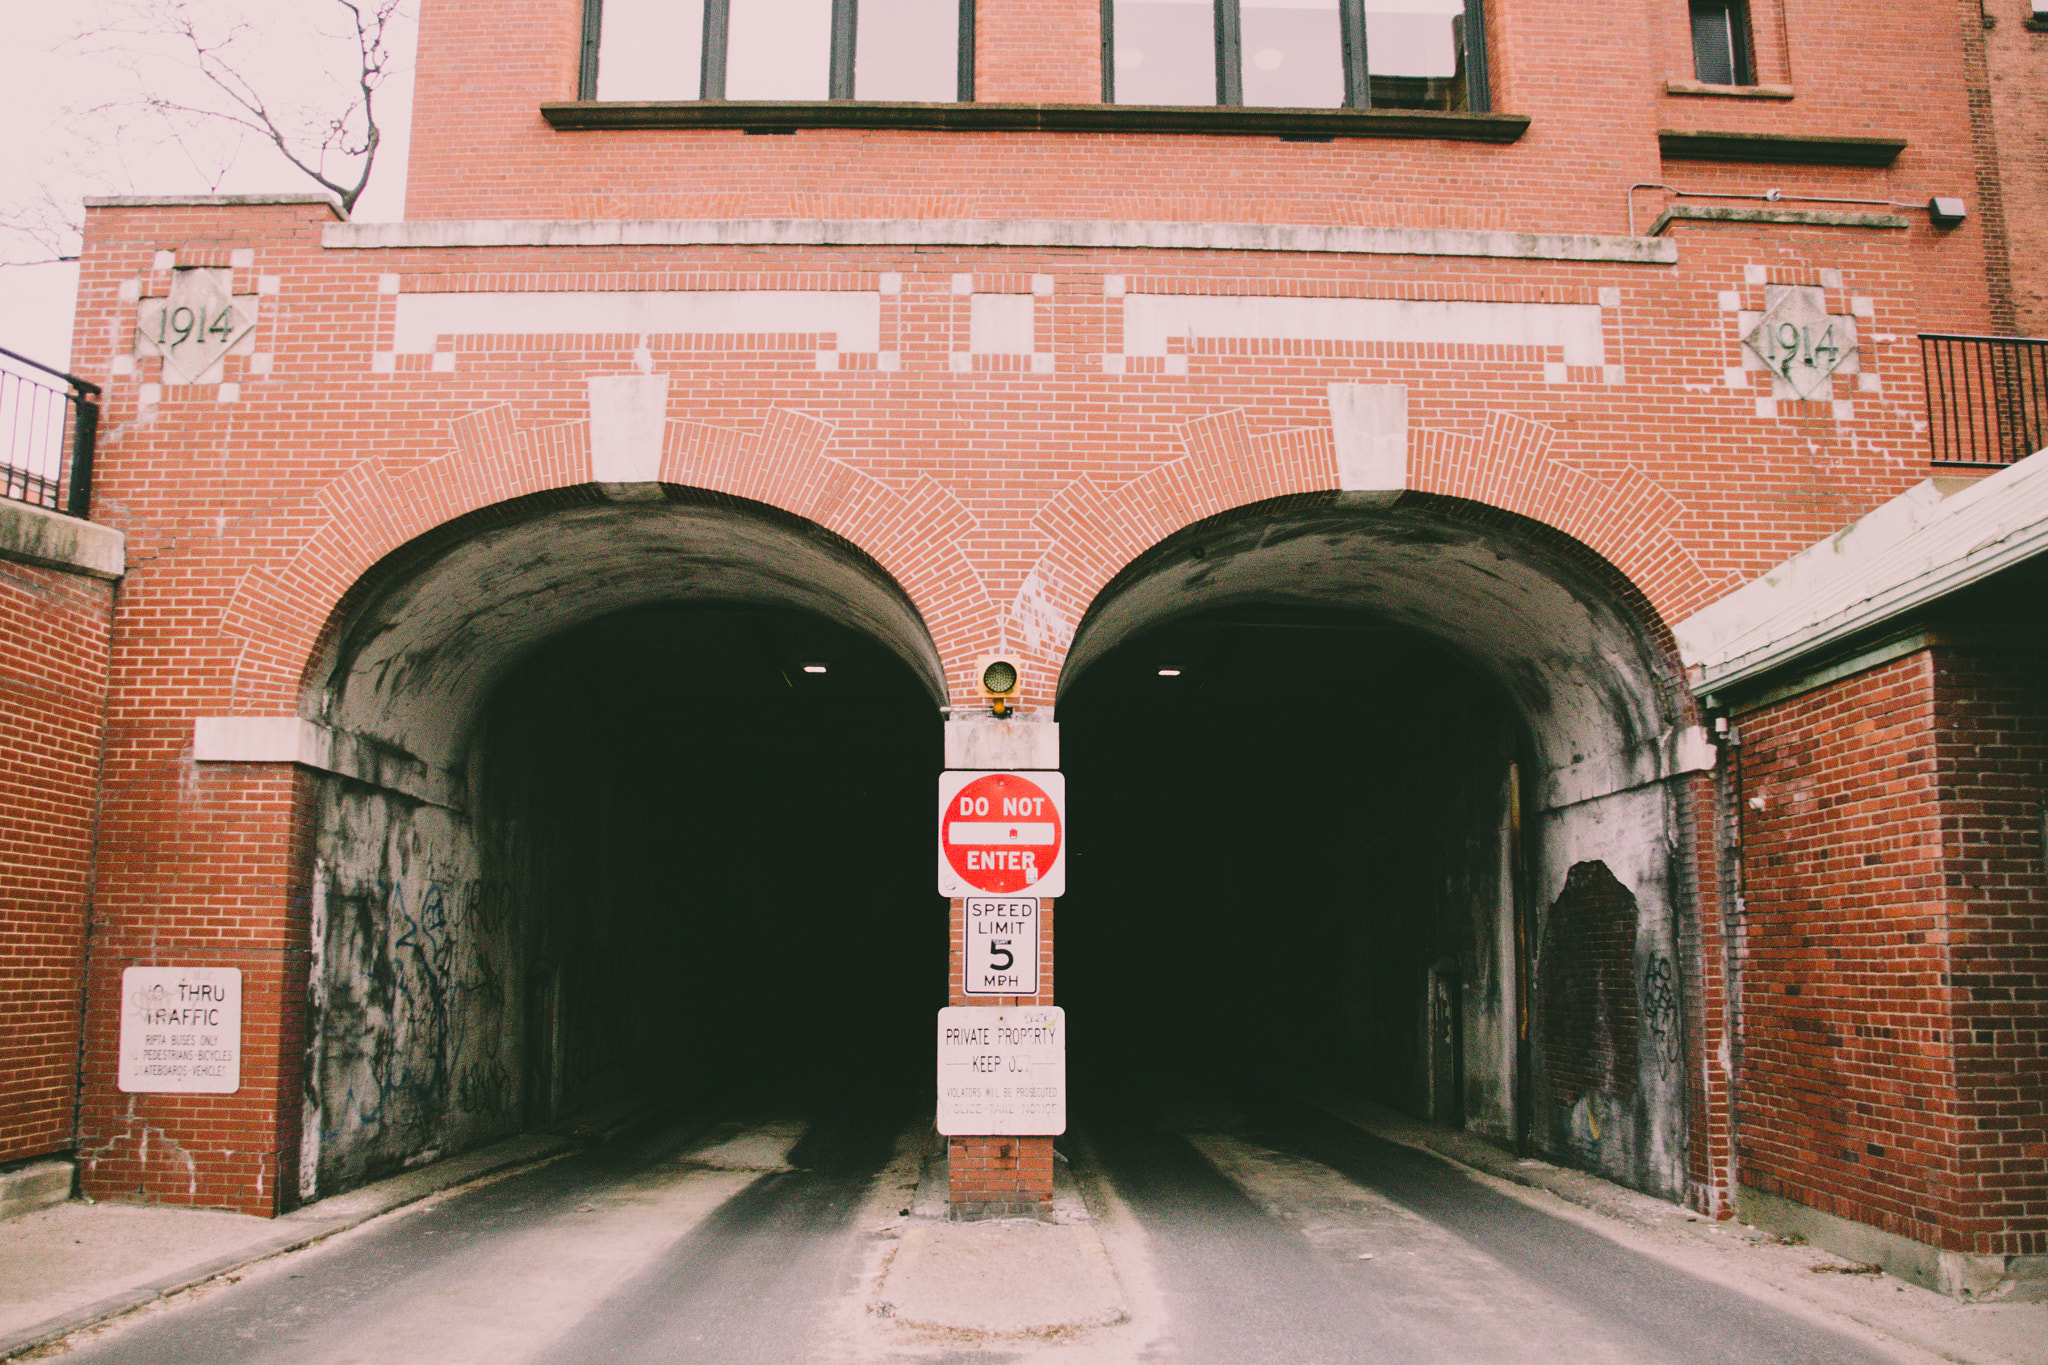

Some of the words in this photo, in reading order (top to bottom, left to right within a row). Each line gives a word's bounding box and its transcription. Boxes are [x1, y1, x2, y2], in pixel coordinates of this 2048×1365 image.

[157, 305, 235, 351] 1914
[1765, 322, 1839, 368] 1914
[960, 797, 989, 816] DO
[1003, 797, 1045, 816] NOT
[967, 851, 1036, 870] ENTER
[972, 903, 1032, 917] SPEED
[978, 921, 1025, 935] LIMIT
[989, 939, 1014, 971] 5
[984, 975, 1018, 987] MPH
[178, 984, 225, 1002] THRU
[171, 1034, 195, 1046] BUSES
[200, 1034, 218, 1047] ONLY
[945, 1028, 990, 1046] PRIVATE
[998, 1027, 1056, 1046] PROPERTY
[972, 1055, 1001, 1073] KEEP
[946, 1087, 981, 1098] VIOLATORS
[985, 1087, 1000, 1098] WILL
[1003, 1087, 1012, 1098] BE
[1016, 1087, 1058, 1098] PROSECUTED
